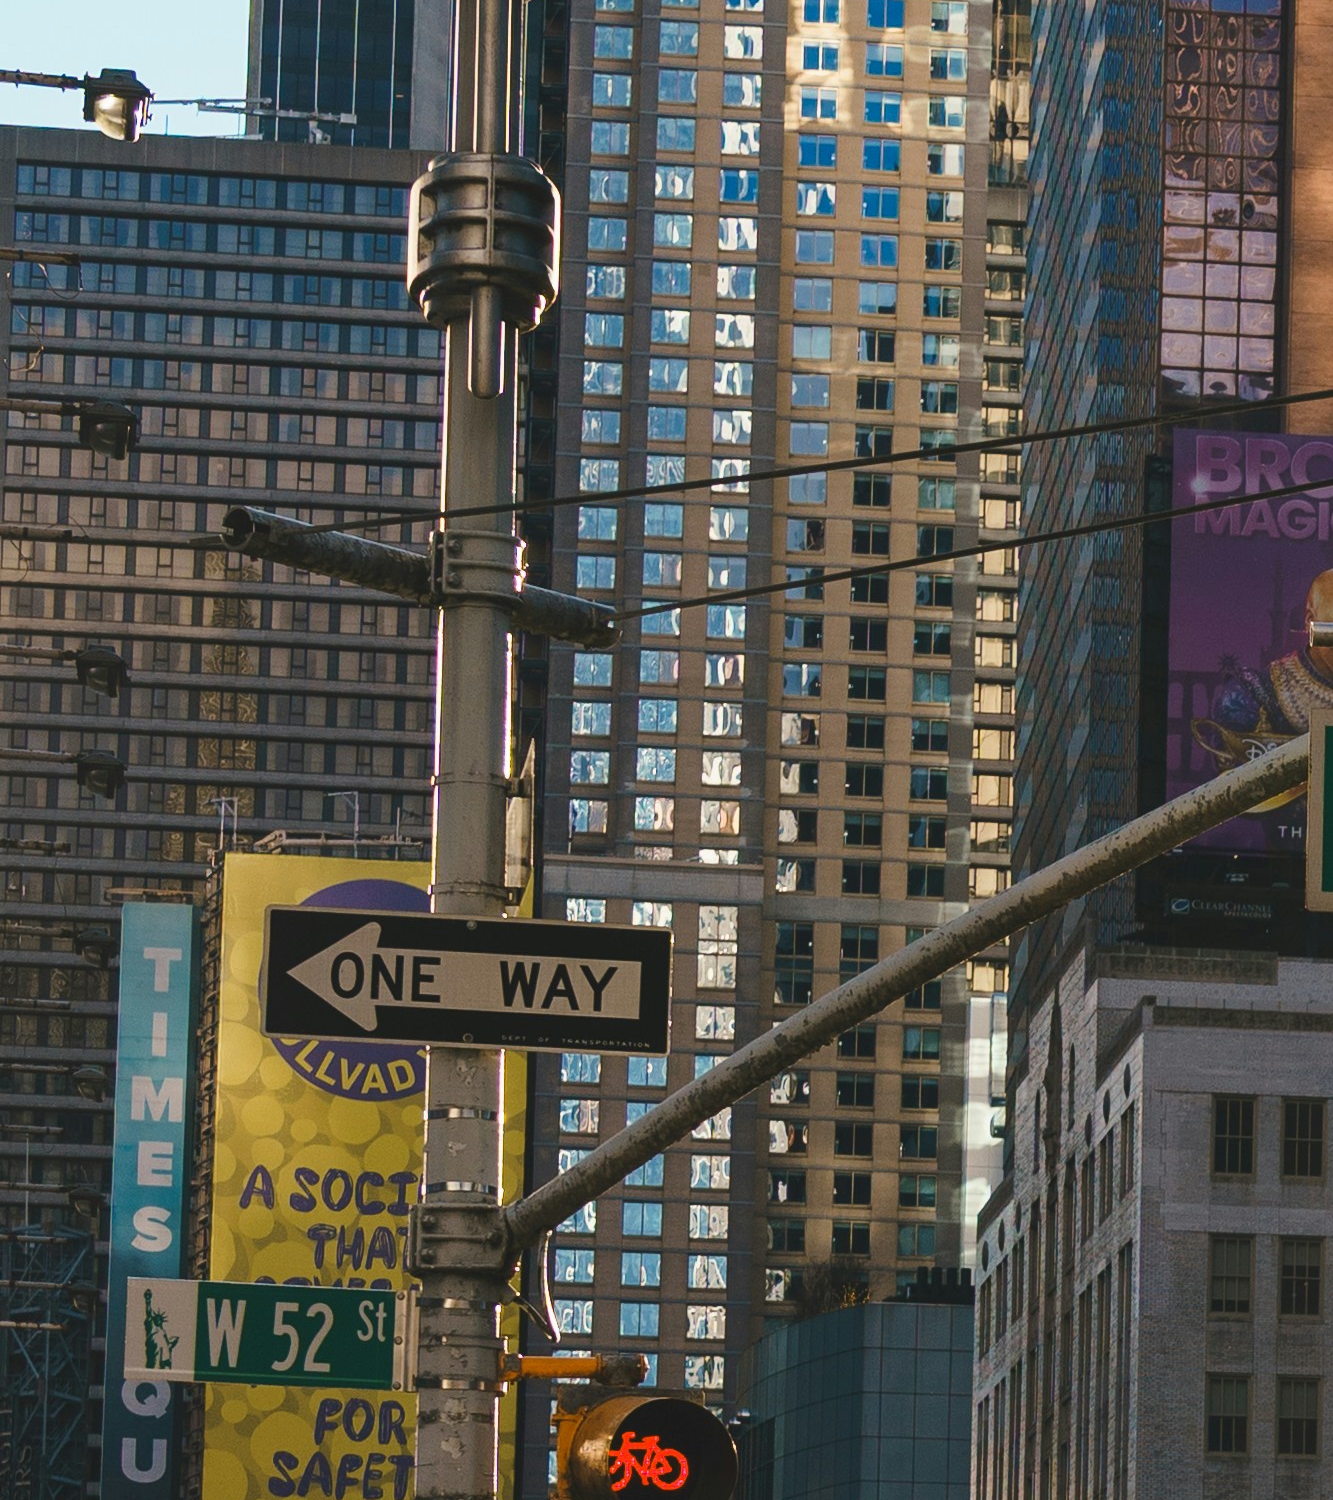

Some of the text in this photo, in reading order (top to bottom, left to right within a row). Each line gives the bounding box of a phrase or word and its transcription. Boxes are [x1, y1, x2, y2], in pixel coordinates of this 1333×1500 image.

[1277, 825, 1303, 839] TH
[329, 950, 618, 1013] ONE WAY
[501, 1034, 651, 1049] DEPT OF TRANSPORTATION
[129, 946, 184, 1255] TIMES
[239, 1164, 424, 1217] A SOCI
[205, 1297, 388, 1373] W 52 St
[314, 1397, 408, 1446] FOR
